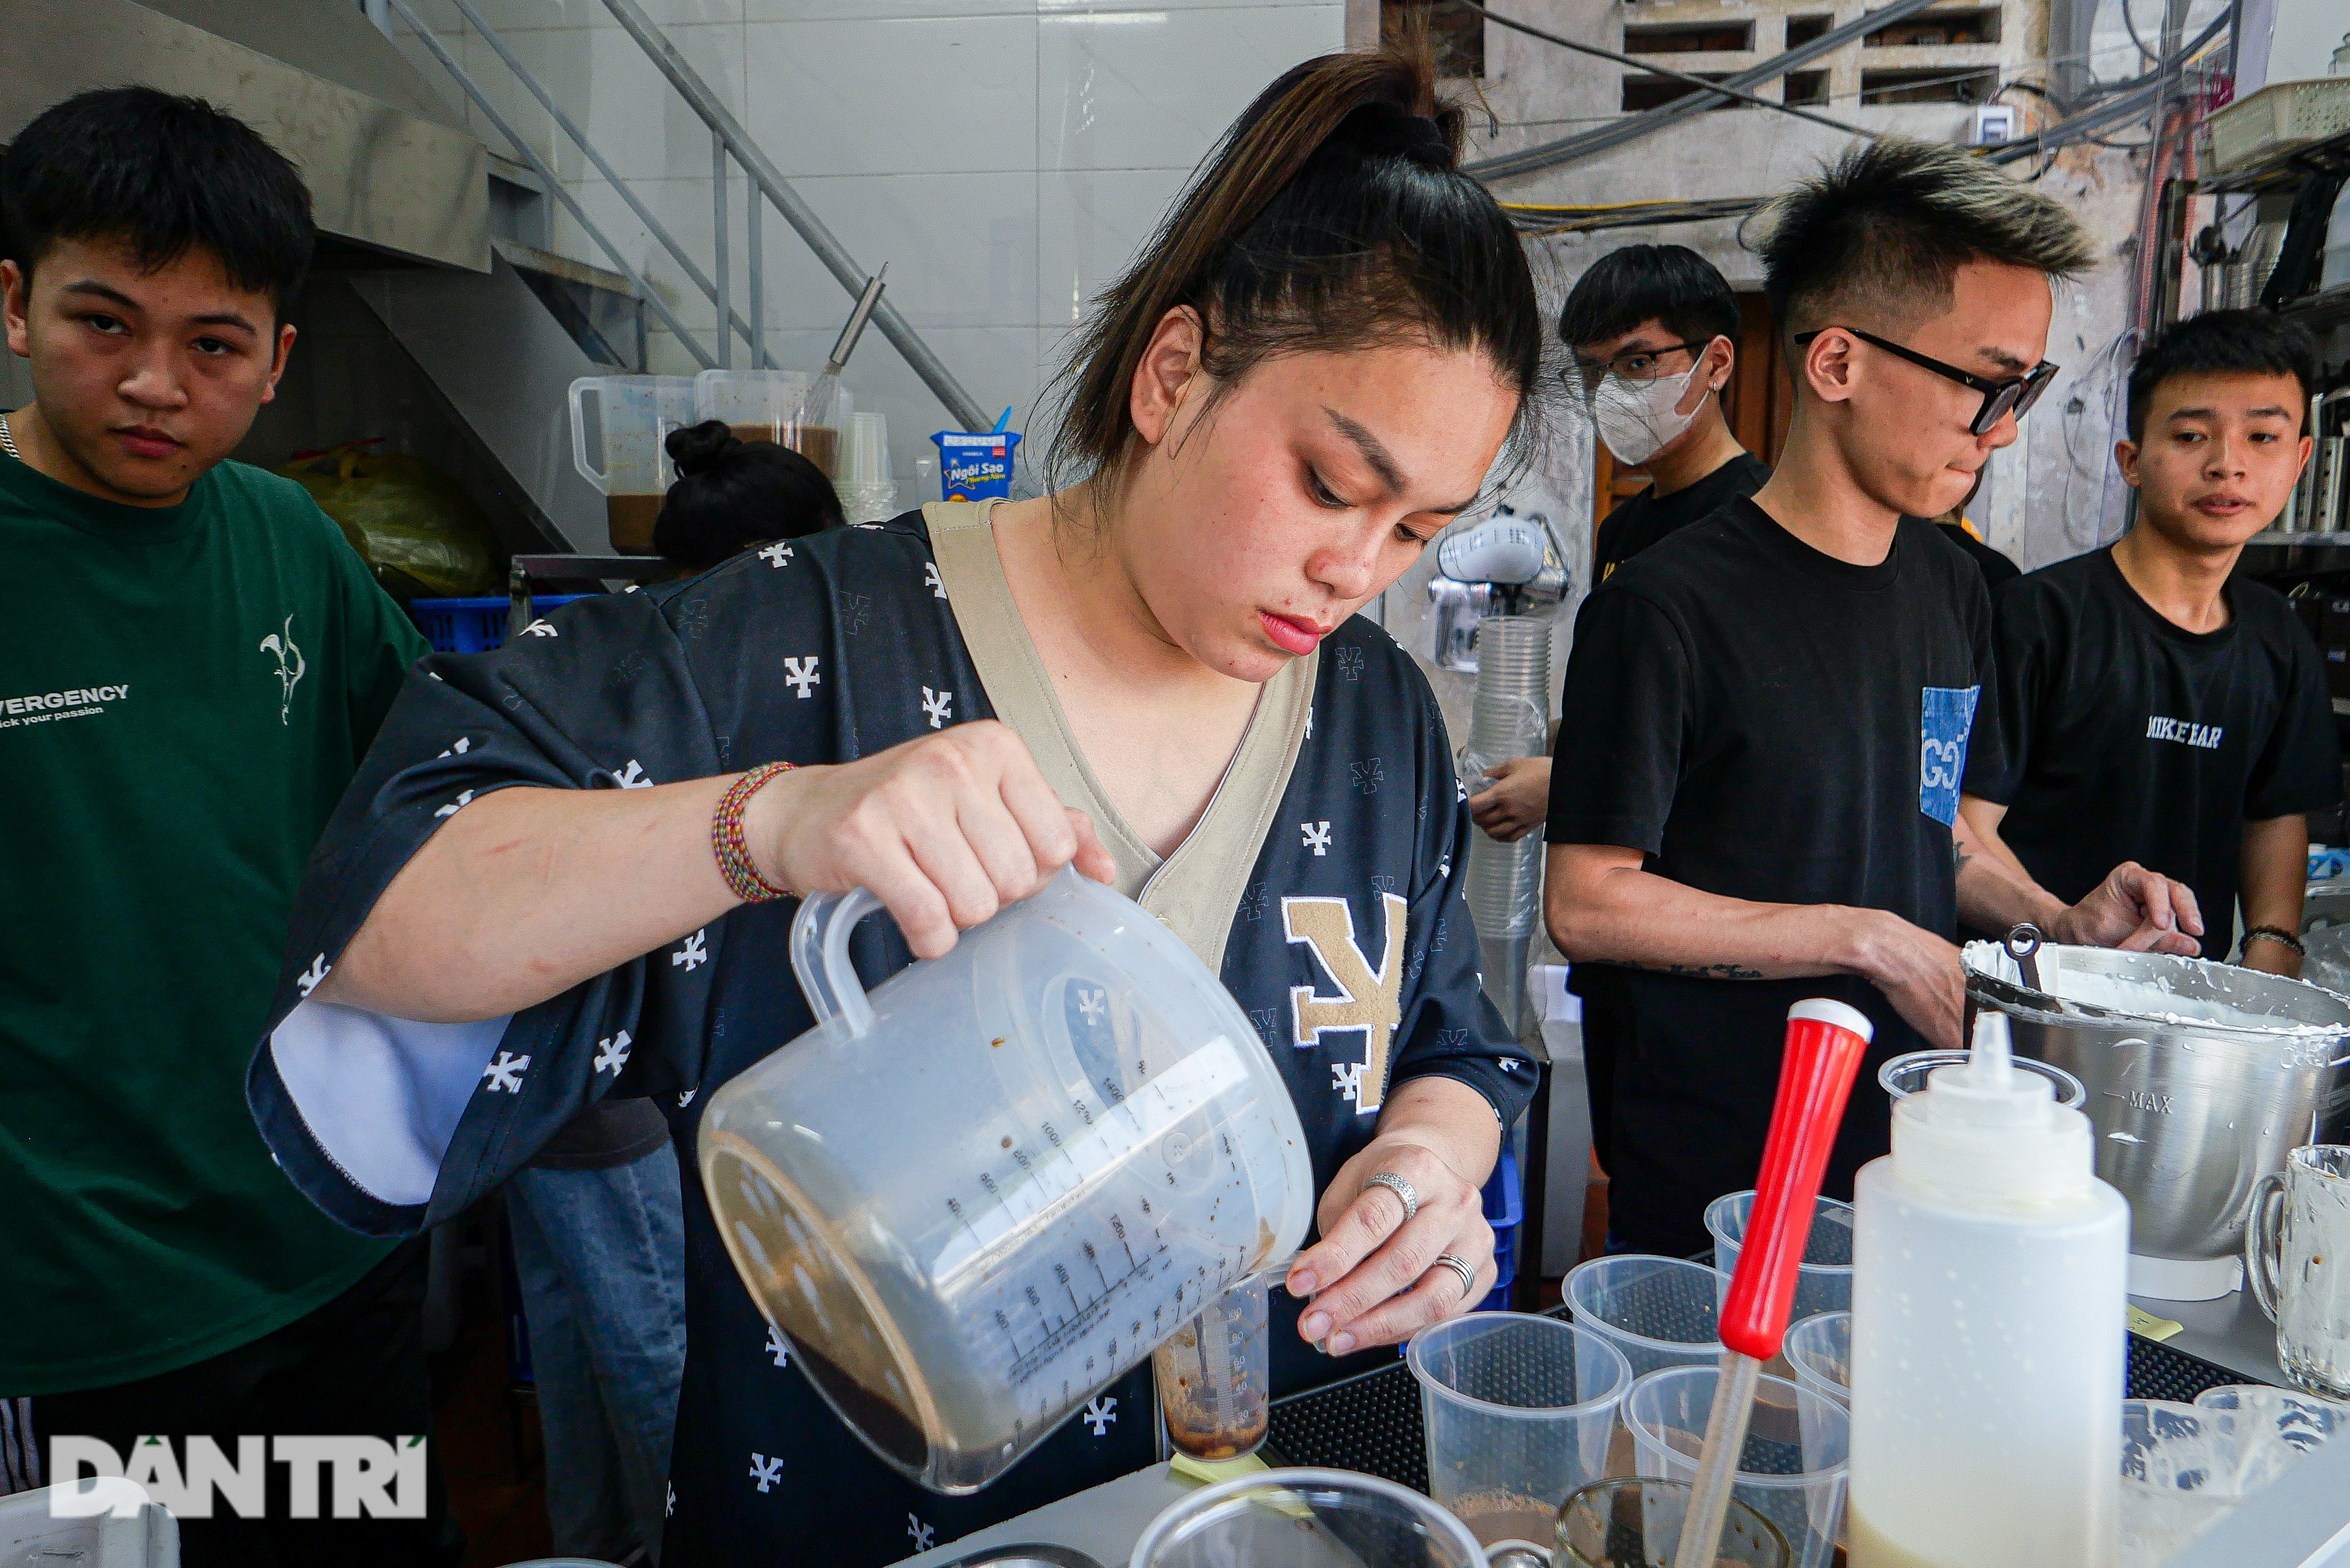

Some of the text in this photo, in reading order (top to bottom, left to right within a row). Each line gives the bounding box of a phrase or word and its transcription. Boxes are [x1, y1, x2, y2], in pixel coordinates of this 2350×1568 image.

[982, 462, 1004, 474] Sao
[0, 684, 129, 716] ERGENCY
[22, 713, 53, 725] your
[54, 706, 104, 721] passion
[2128, 1090, 2174, 1115] MAX
[1042, 1121, 1062, 1148] 1000
